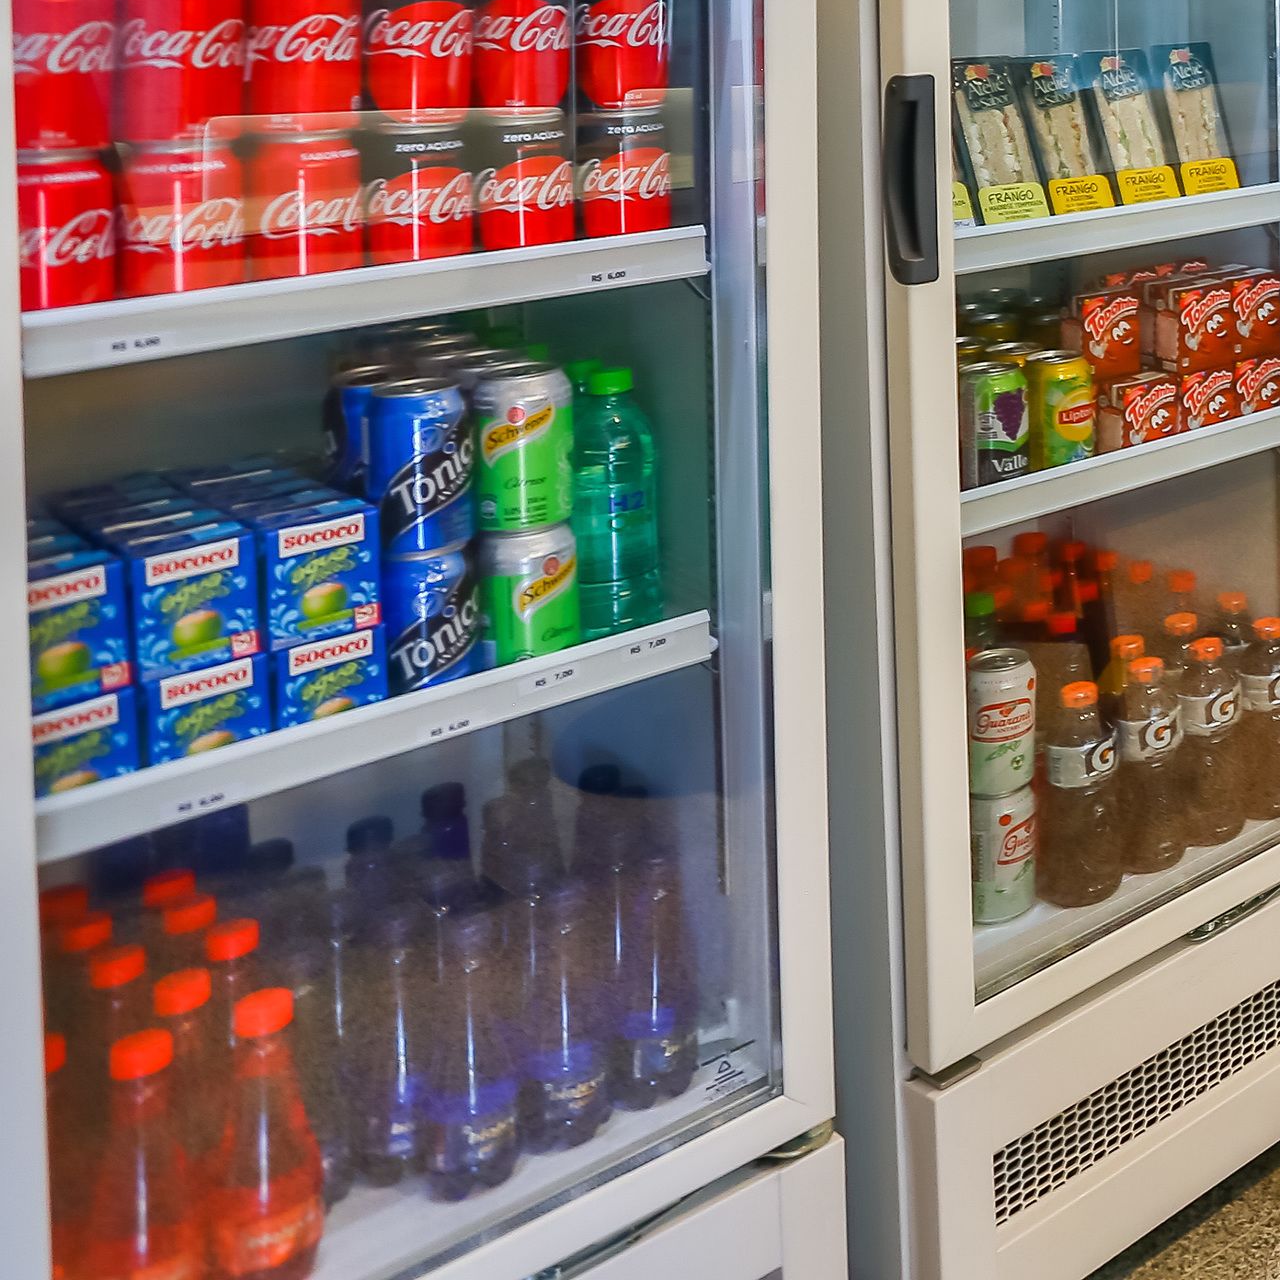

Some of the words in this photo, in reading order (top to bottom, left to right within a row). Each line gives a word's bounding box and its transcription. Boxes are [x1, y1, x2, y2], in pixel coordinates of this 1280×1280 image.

[363, 8, 475, 58] Coca-Co
[607, 125, 635, 134] zero
[502, 133, 532, 143] zero
[394, 142, 425, 153] zero
[579, 152, 671, 202] Coca-Co
[1189, 164, 1228, 178] FRANGO
[1125, 172, 1166, 186] FRANGO
[474, 160, 574, 213] Coca-Co
[1055, 181, 1099, 195] FRANGO
[368, 172, 473, 227] Coca-Co
[988, 189, 1034, 204] FRANGO
[607, 269, 626, 280] 6,00
[648, 638, 666, 649] 7,00
[1211, 694, 1237, 723] G
[1145, 720, 1172, 750] G
[1091, 737, 1116, 771] G
